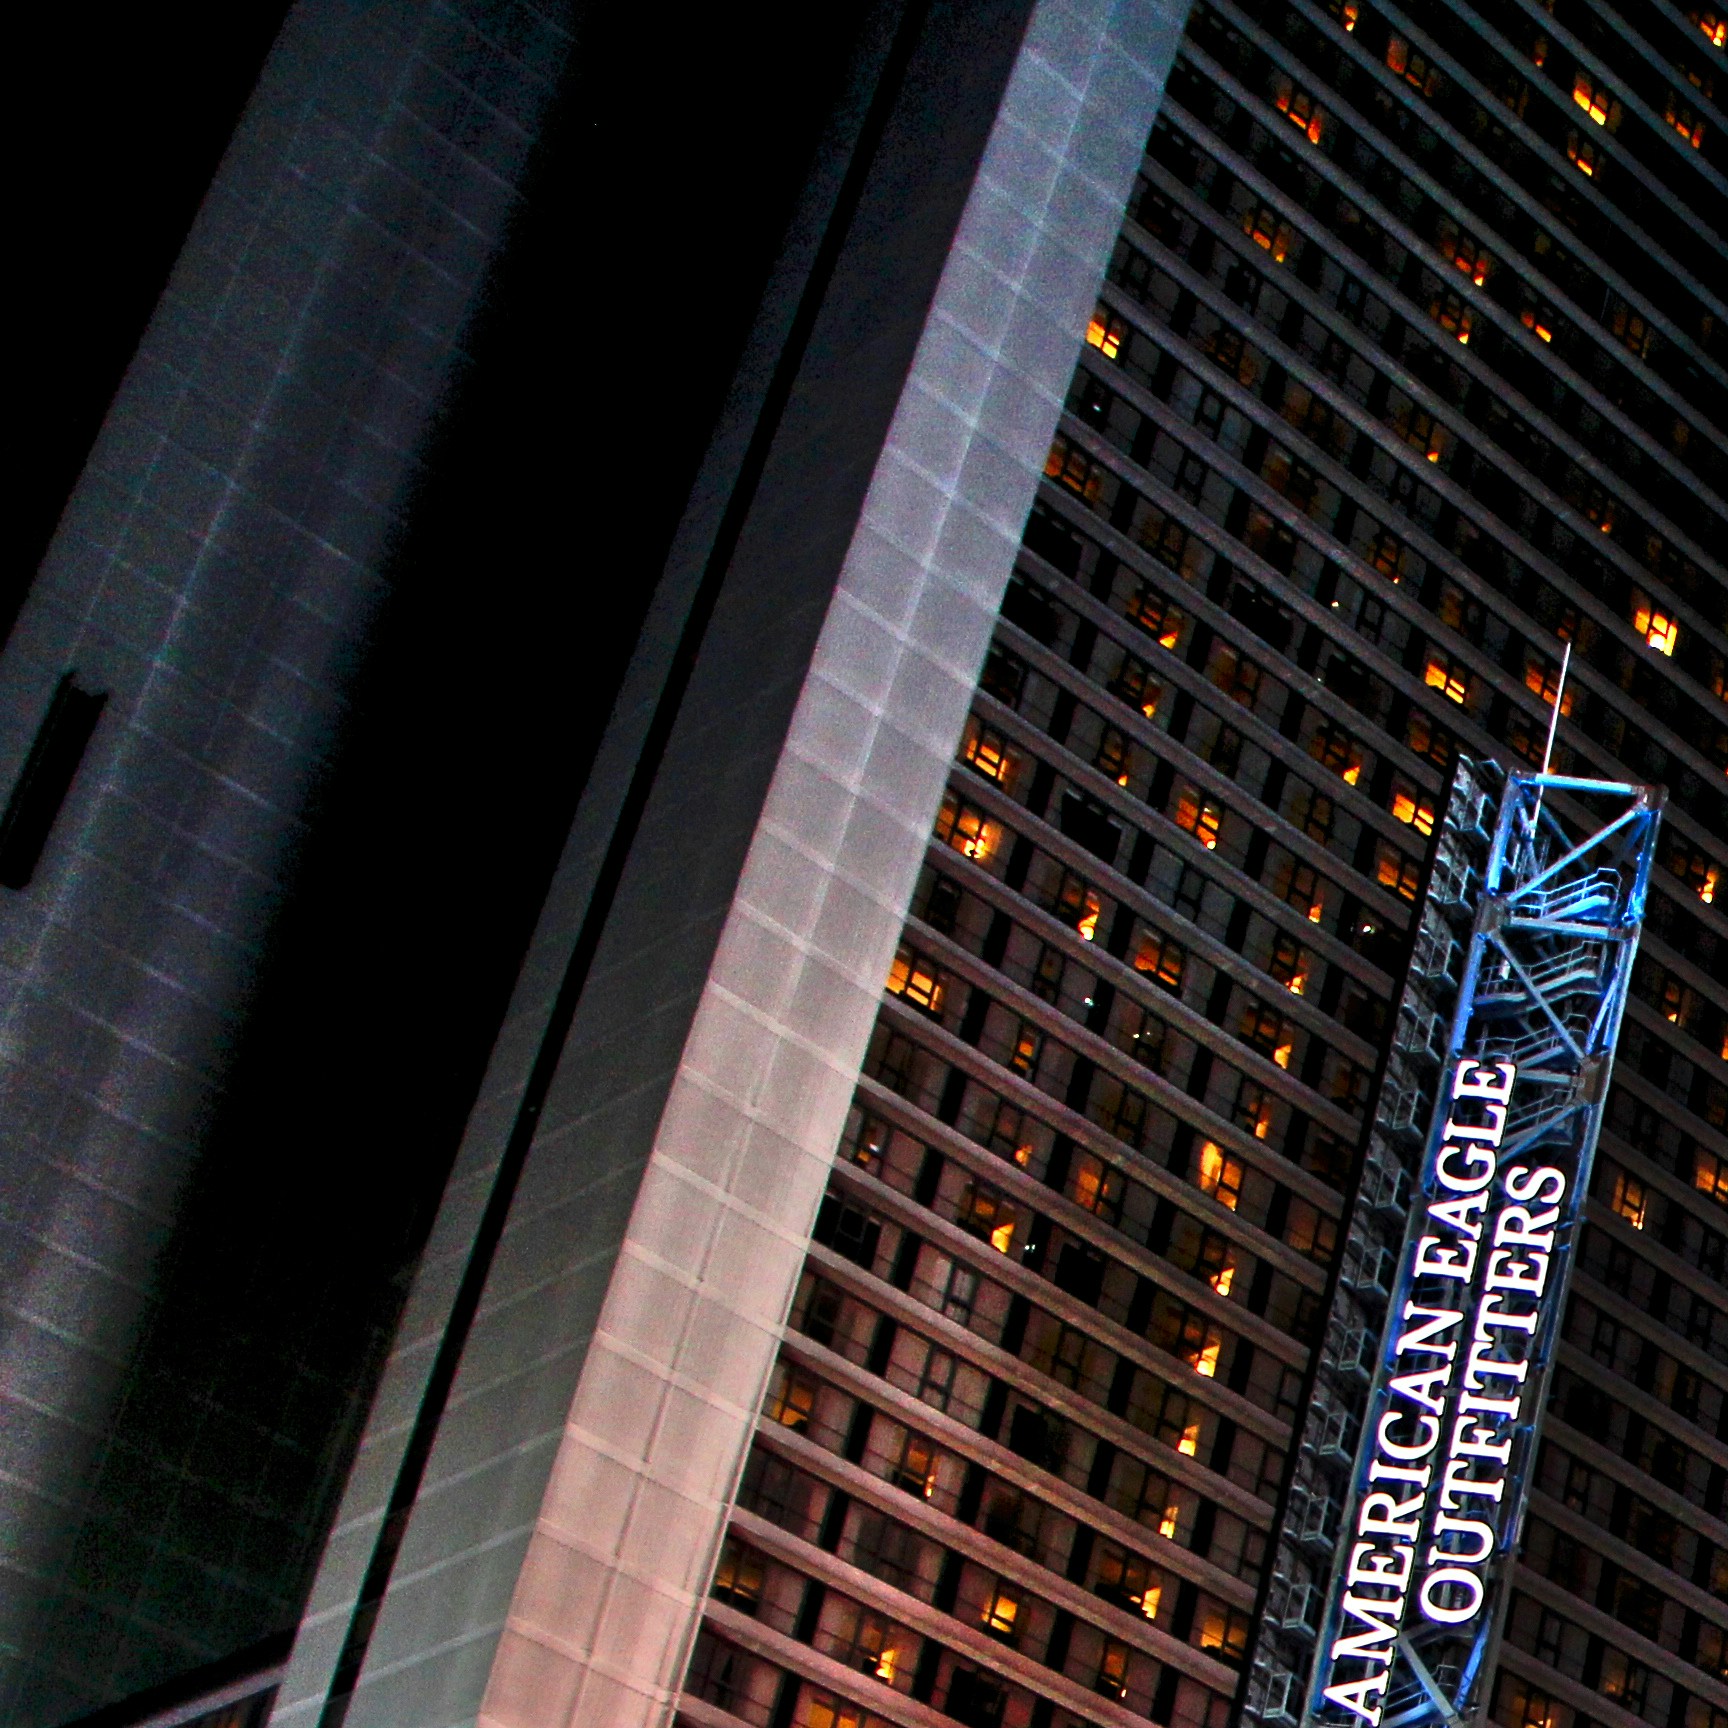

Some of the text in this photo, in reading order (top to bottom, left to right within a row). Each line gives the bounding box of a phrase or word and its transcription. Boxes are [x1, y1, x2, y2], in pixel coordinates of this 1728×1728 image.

[1322, 1056, 1516, 1727] AMERICAN EAGLE
[1420, 1165, 1568, 1624] OUTFITTERS
